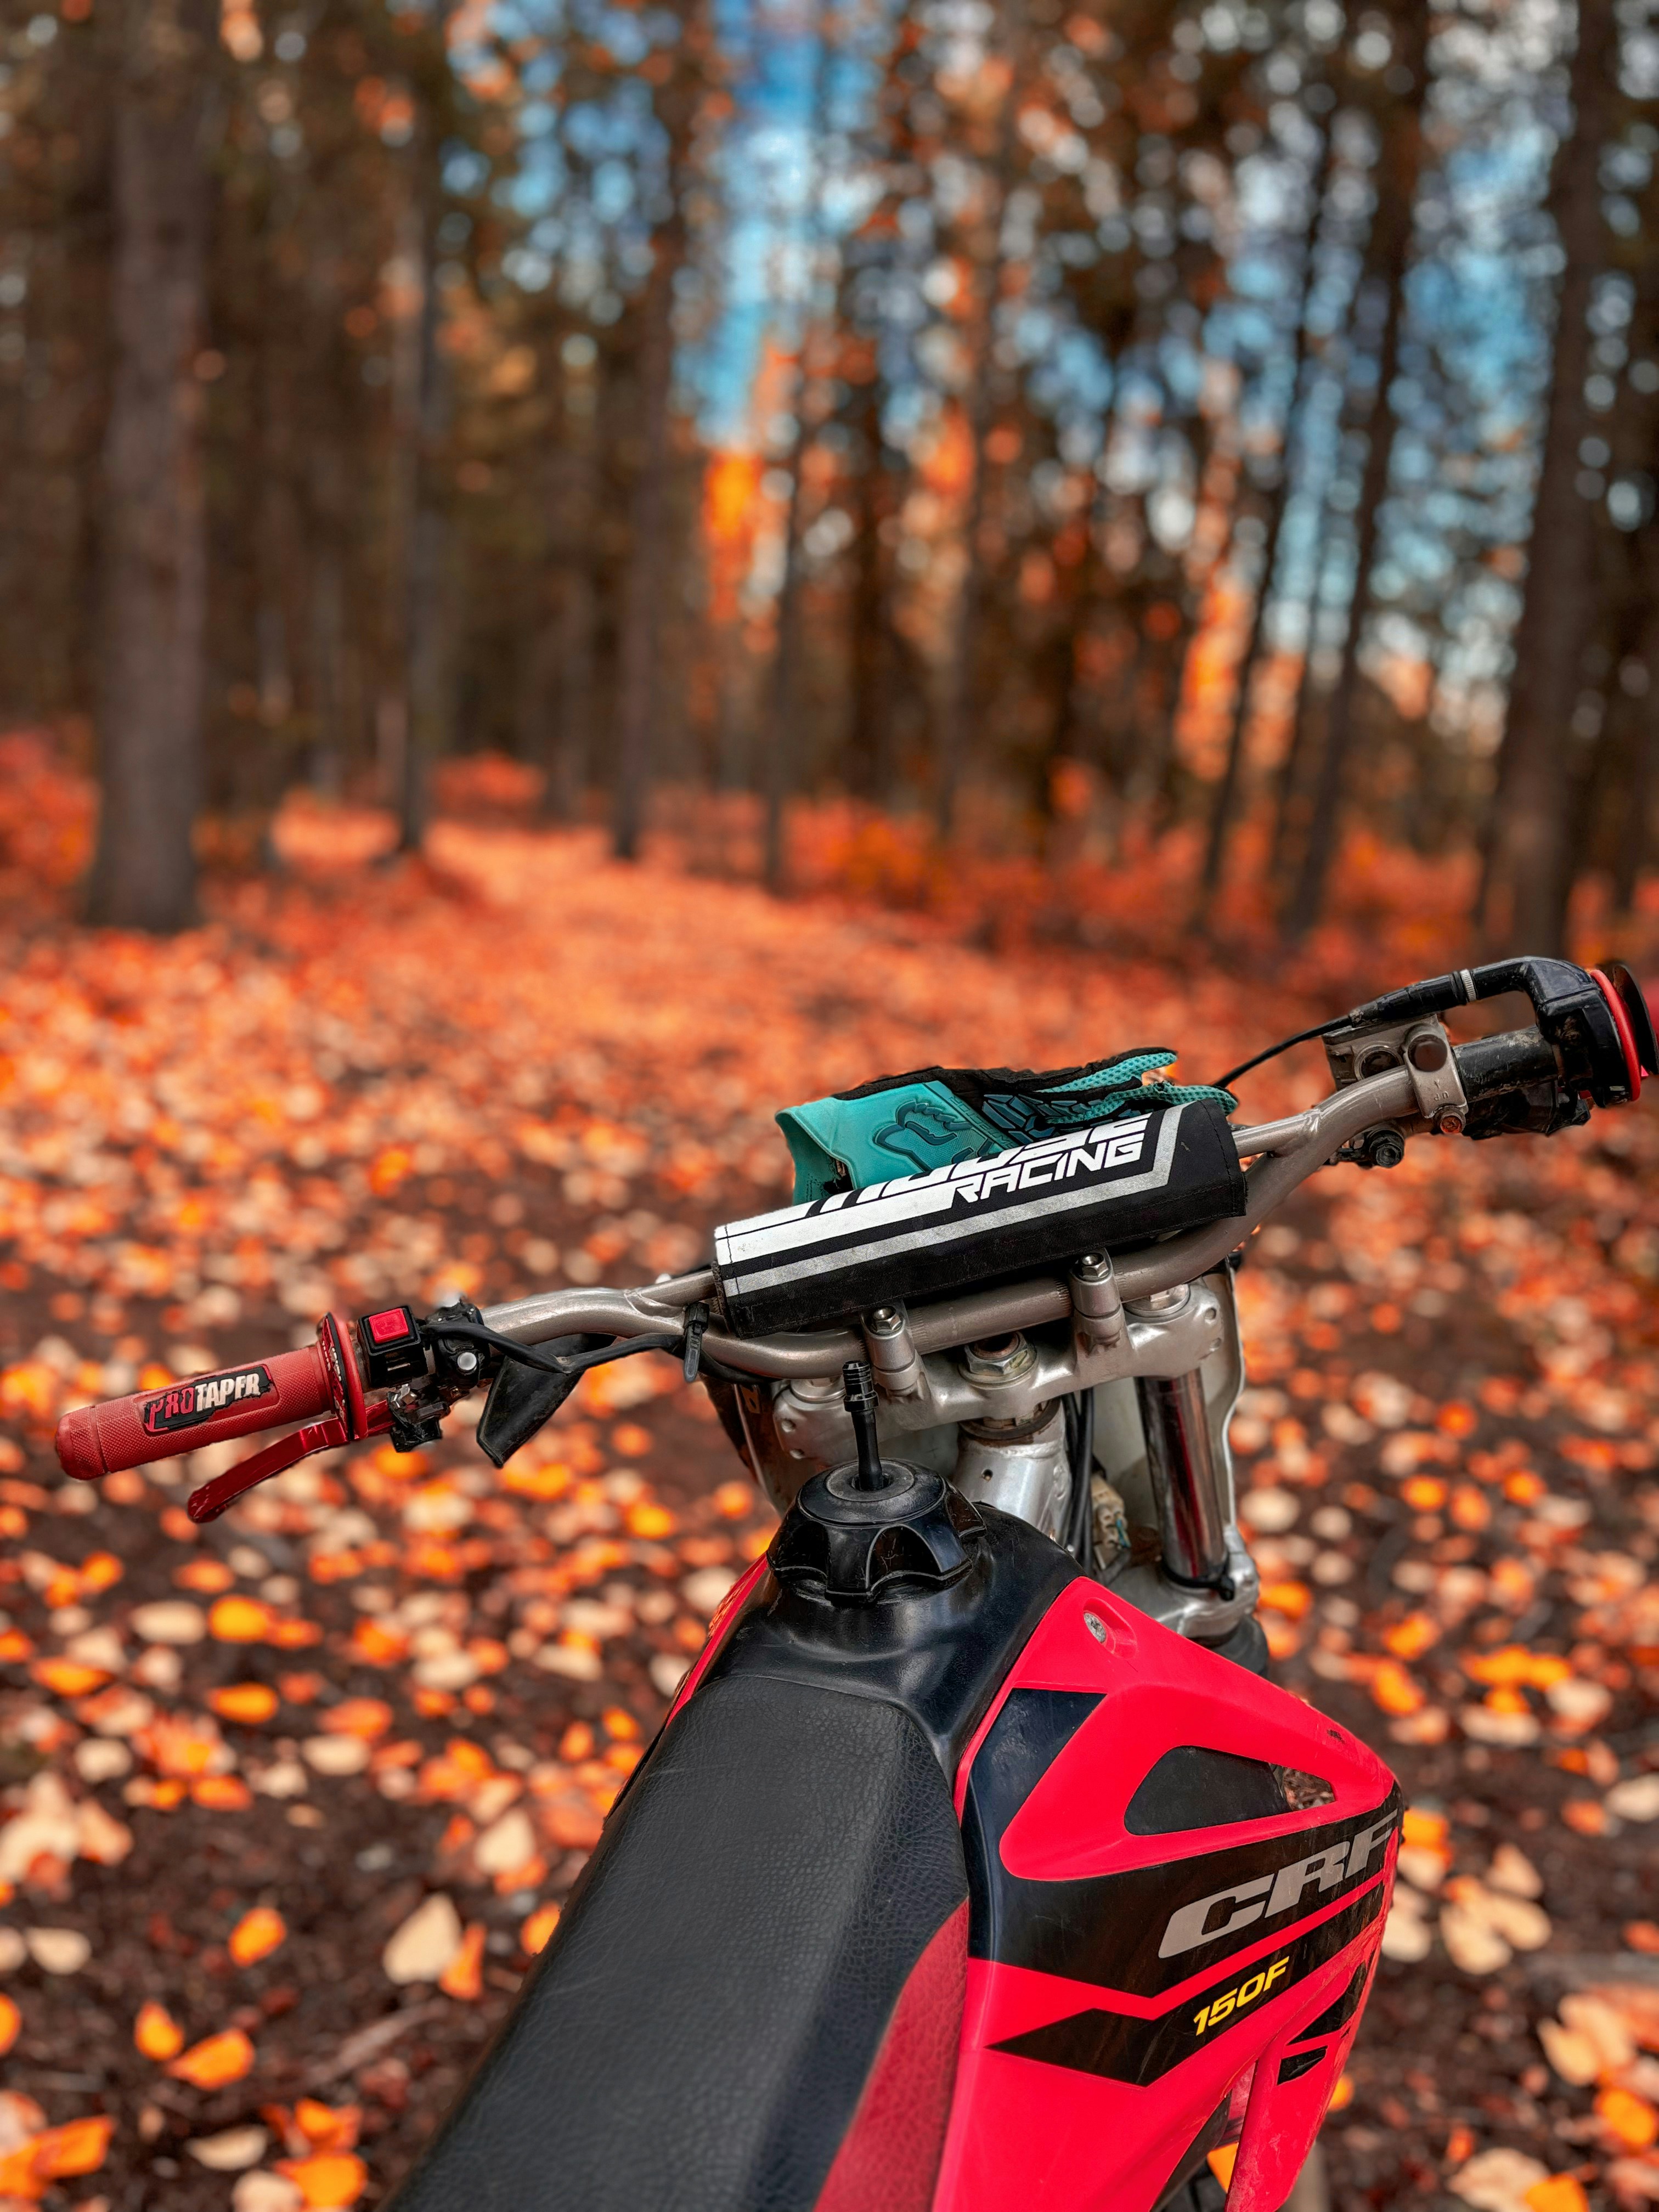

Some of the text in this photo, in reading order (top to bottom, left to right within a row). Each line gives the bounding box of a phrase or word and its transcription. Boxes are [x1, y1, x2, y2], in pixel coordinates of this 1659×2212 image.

[941, 1132, 1145, 1209] RACING
[1158, 1808, 1398, 1959] CRF
[1193, 1955, 1290, 2036] 150F
